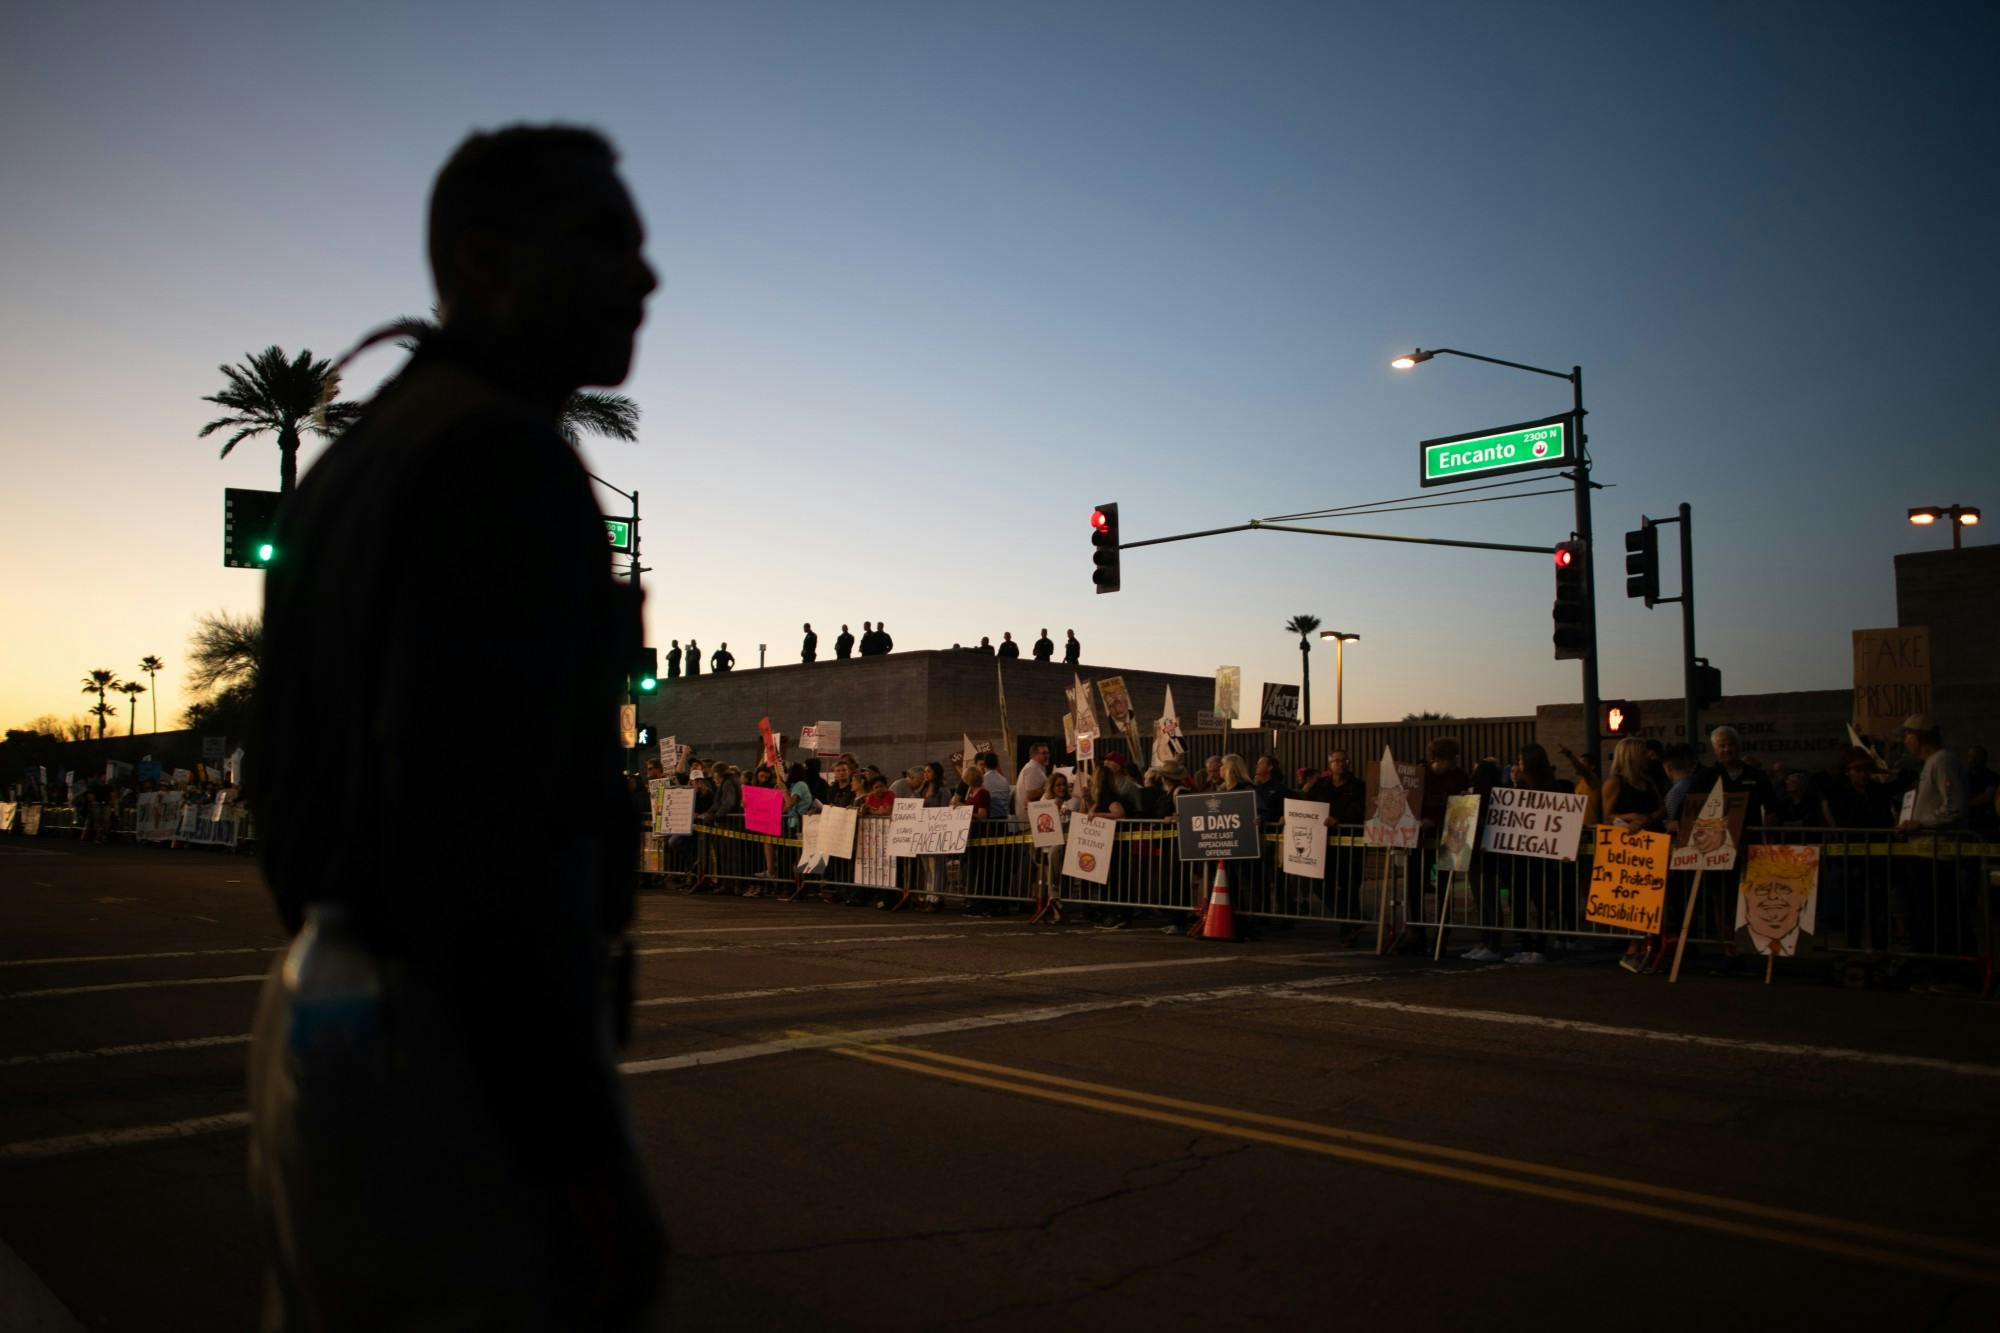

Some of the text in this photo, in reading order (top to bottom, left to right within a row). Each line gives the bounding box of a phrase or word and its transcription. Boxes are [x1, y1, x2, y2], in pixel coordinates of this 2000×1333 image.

[1523, 429, 1557, 443] 2300 N
[1439, 443, 1516, 469] Encanto
[1861, 636, 1926, 672] FAKE
[1855, 683, 1930, 717] PRESIDENT
[1267, 704, 1298, 721] NEWS
[1491, 789, 1586, 813] NO HUMAN
[1207, 814, 1241, 830] DAYS
[1288, 811, 1320, 821] DENOUNCE
[1487, 807, 1562, 833] BEING IS
[911, 828, 969, 853] FAKE NEWS
[1083, 827, 1101, 838] CON
[1200, 831, 1234, 840] SINCE LAST
[1600, 828, 1655, 850] I Can't
[1077, 837, 1105, 850] TRUMP
[1198, 840, 1240, 849] IMPEACHABLE
[1205, 848, 1233, 857] OFFENSE
[1493, 832, 1560, 856] ILLEGAL
[1607, 849, 1655, 869] believe
[1673, 853, 1698, 866] DUH
[1593, 866, 1665, 890] I'm Protesting
[1611, 886, 1640, 899] for
[1586, 894, 1660, 930] Sensibility!
